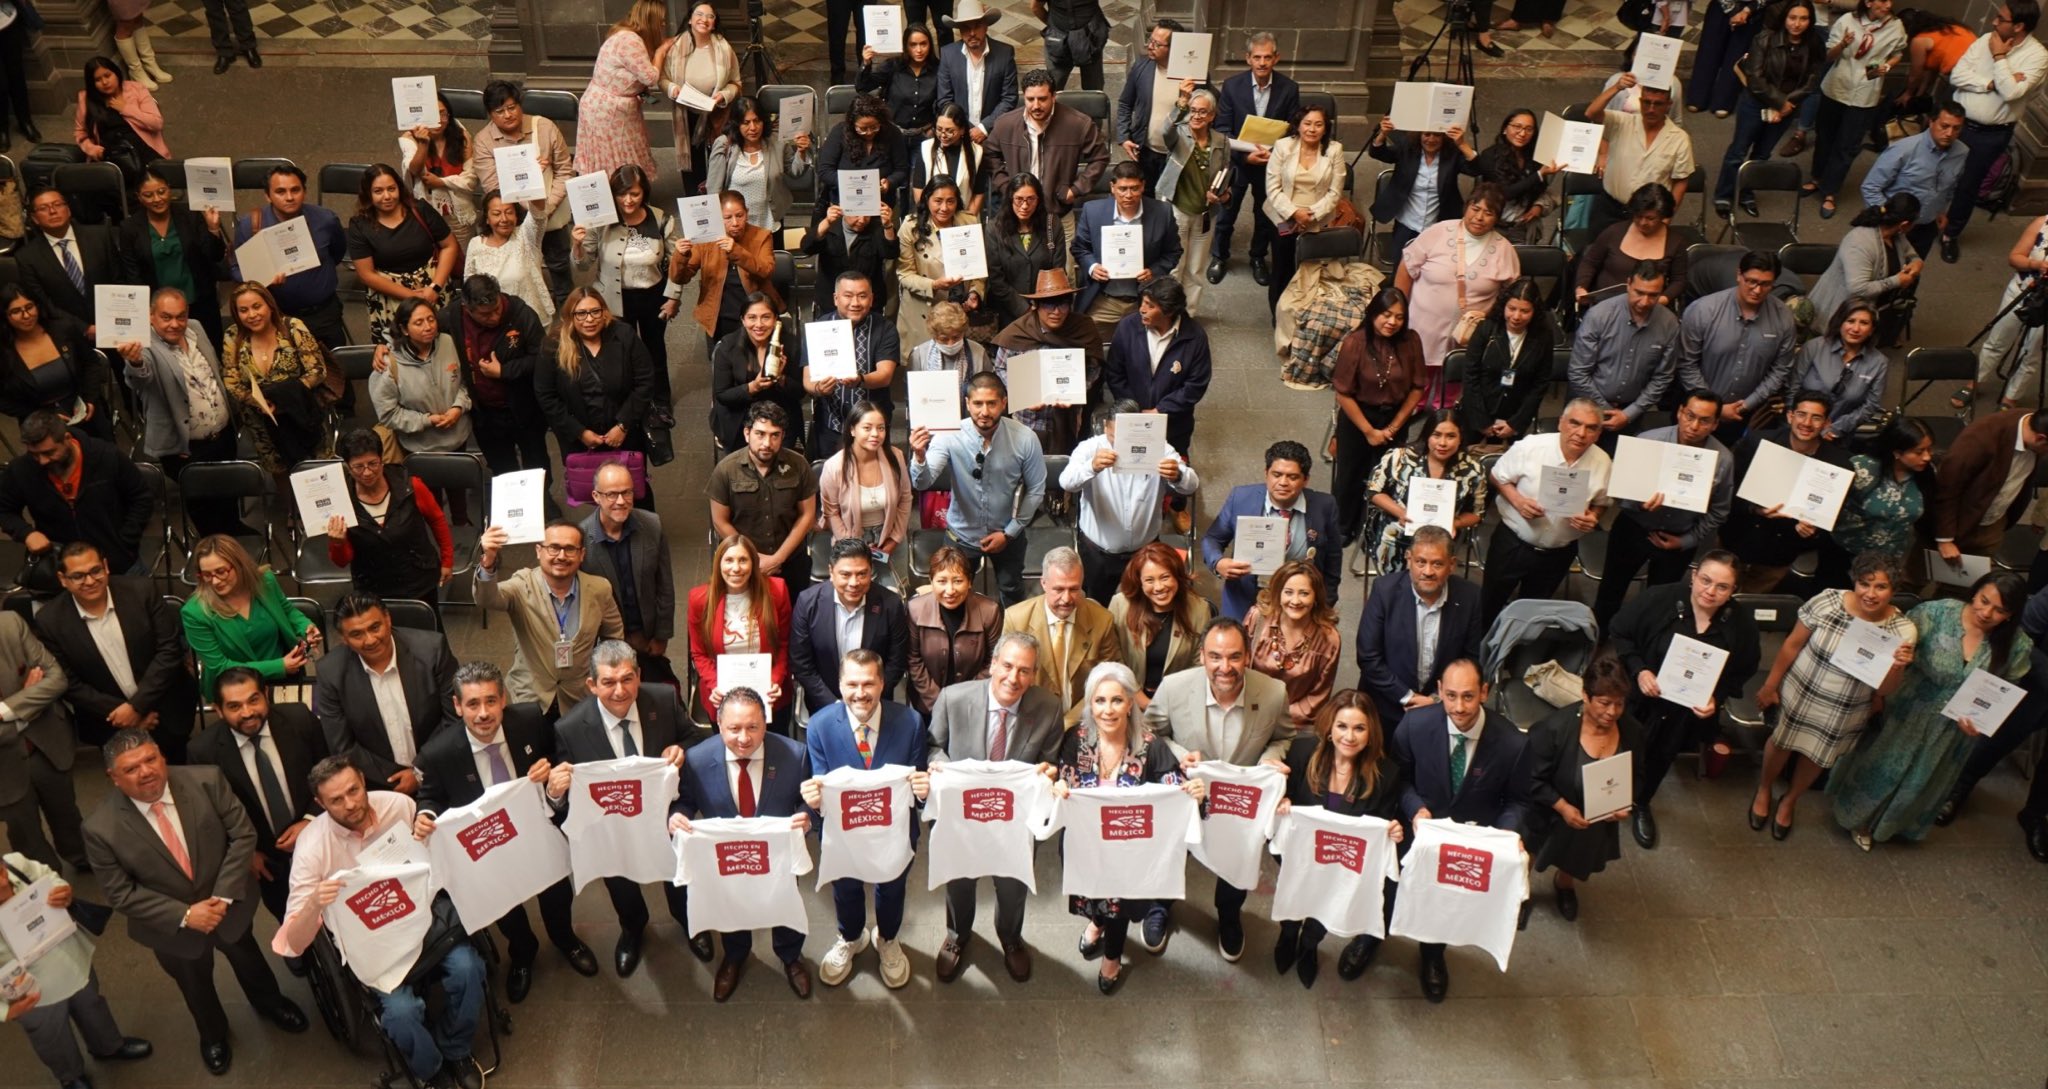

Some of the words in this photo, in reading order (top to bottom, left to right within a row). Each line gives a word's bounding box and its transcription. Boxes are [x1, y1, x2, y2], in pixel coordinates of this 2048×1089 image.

[465, 822, 489, 837] HECHO
[490, 815, 500, 823] EN
[1323, 835, 1347, 843] HECHO
[1447, 851, 1472, 860] HECHO
[356, 887, 379, 904] HECHO
[380, 880, 390, 889] EN
